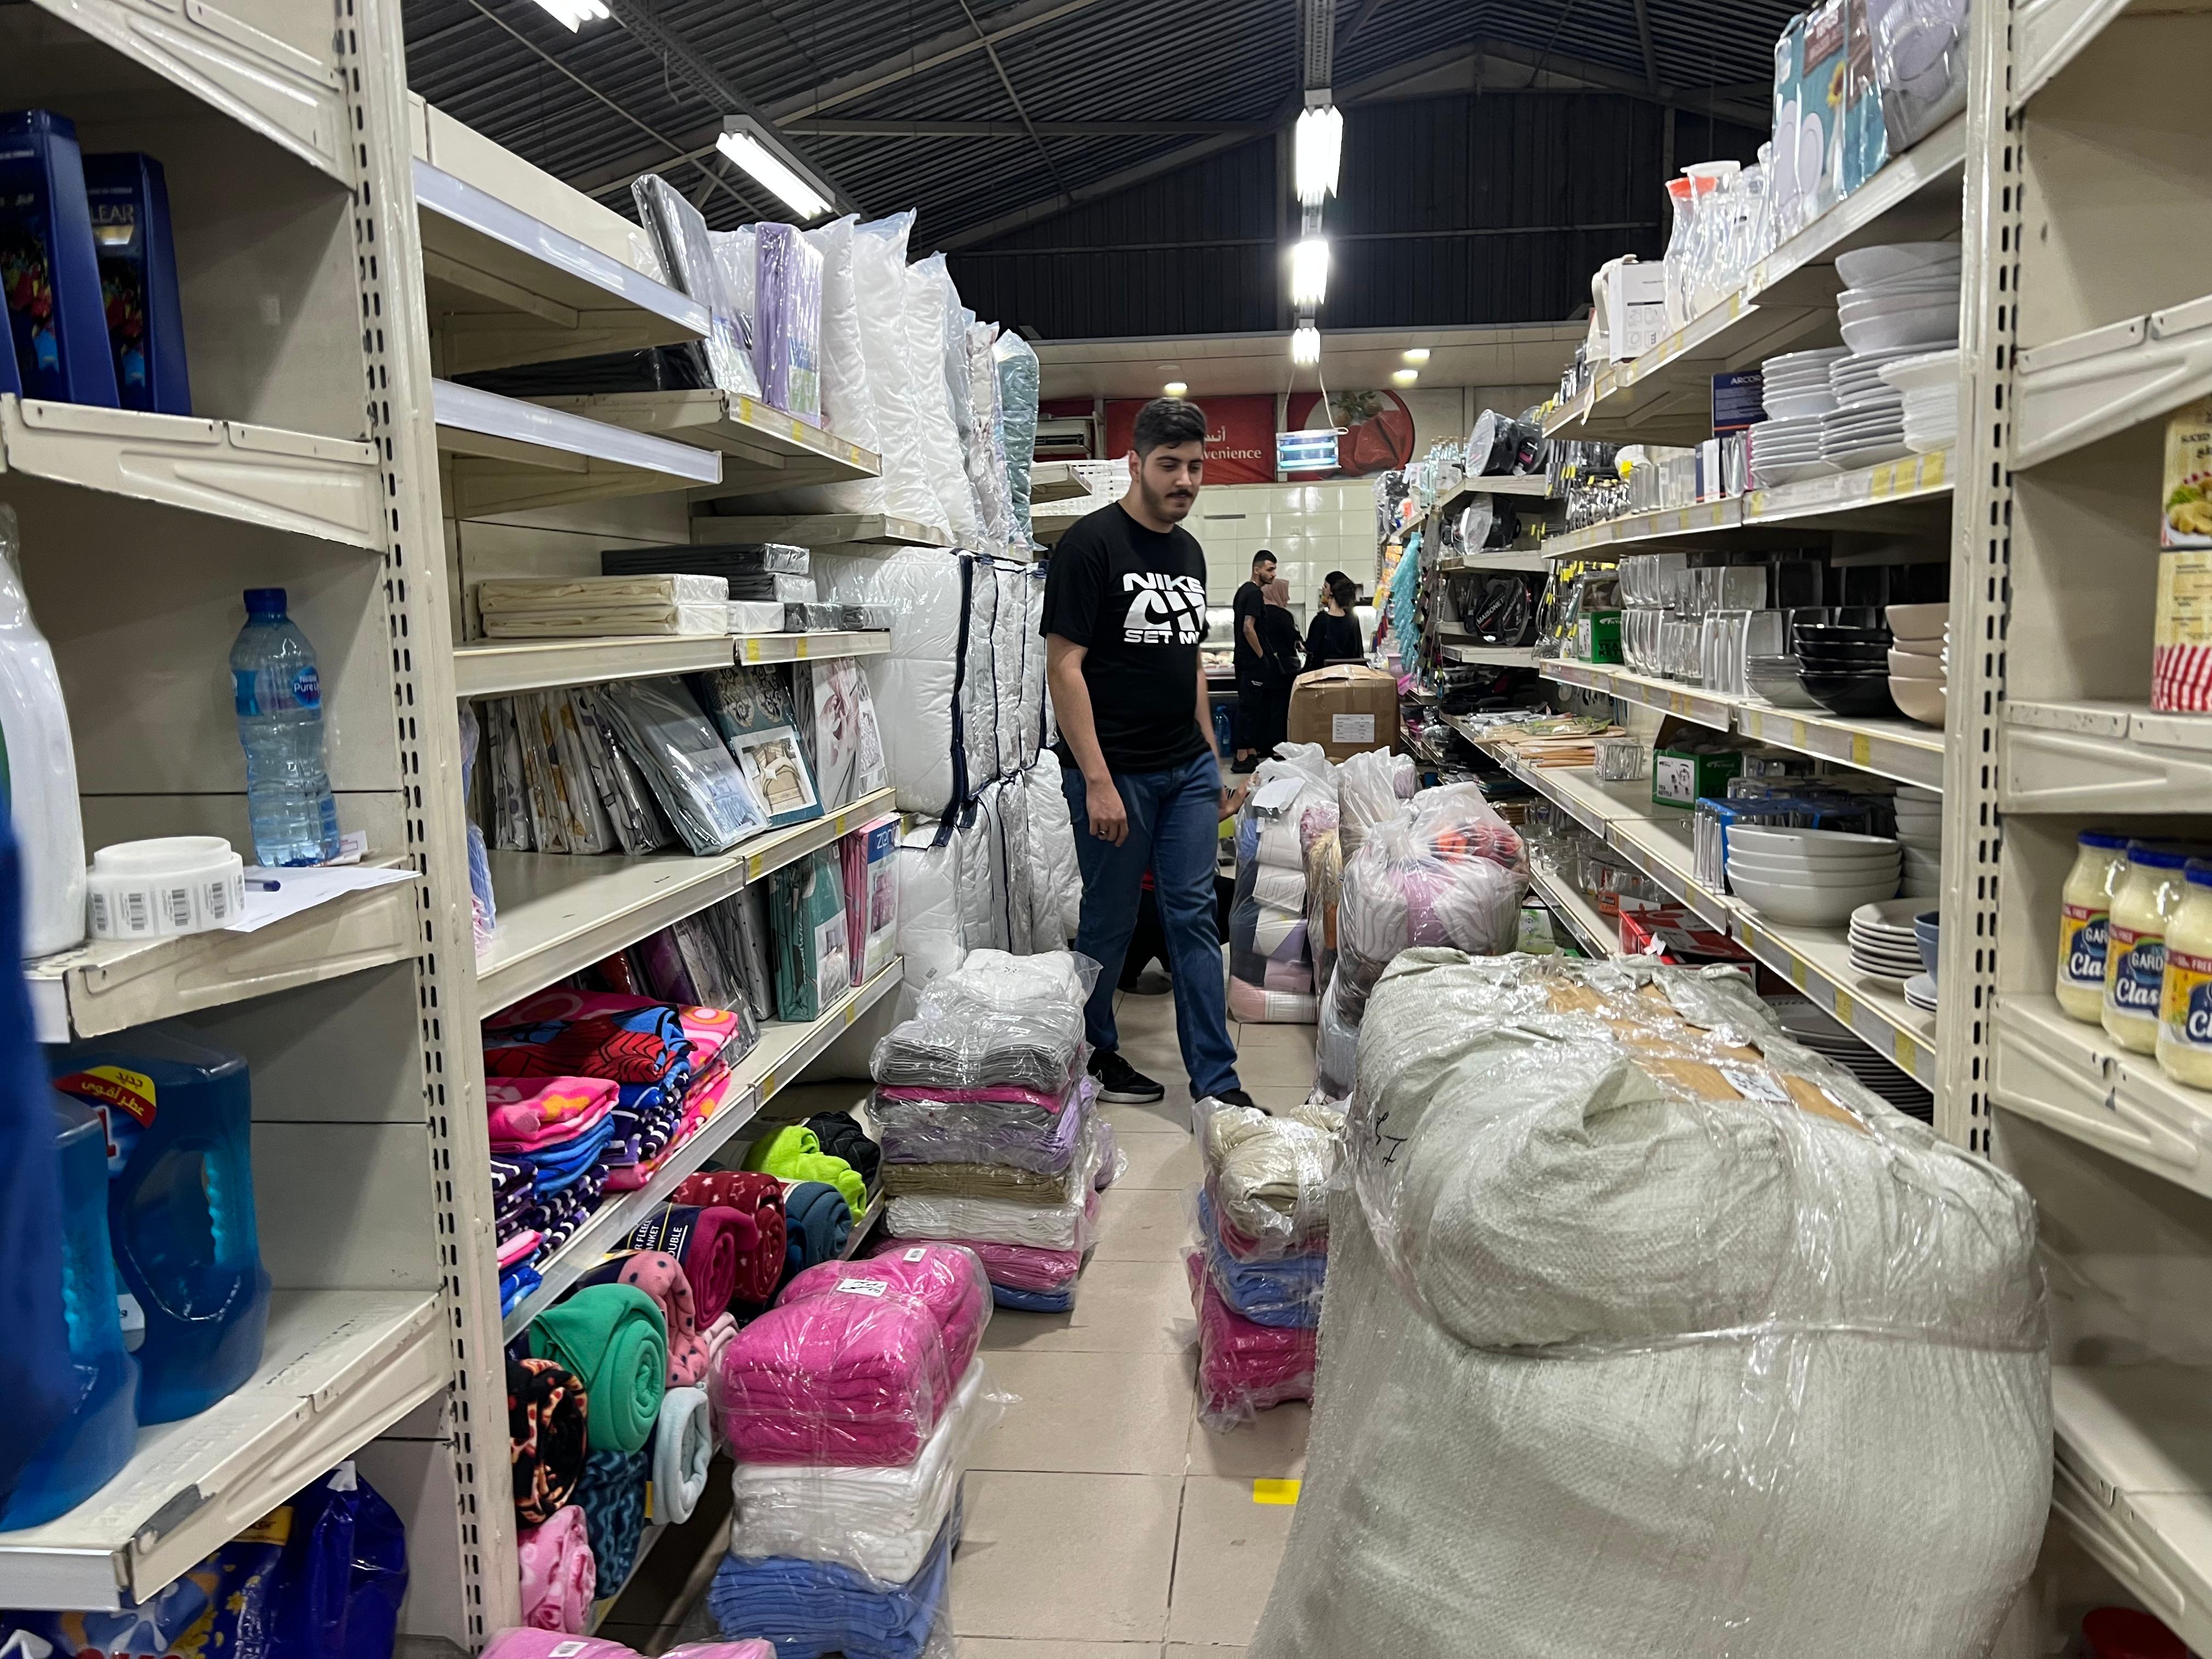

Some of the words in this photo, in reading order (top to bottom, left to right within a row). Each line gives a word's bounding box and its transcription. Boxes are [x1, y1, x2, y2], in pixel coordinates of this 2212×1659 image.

[1122, 572, 1206, 595] NIKE
[1124, 629, 1173, 644] SET
[294, 682, 313, 692] Pure
[2116, 978, 2159, 1006] Clas
[114, 1071, 143, 1089] جديد
[117, 1096, 145, 1117] عطر
